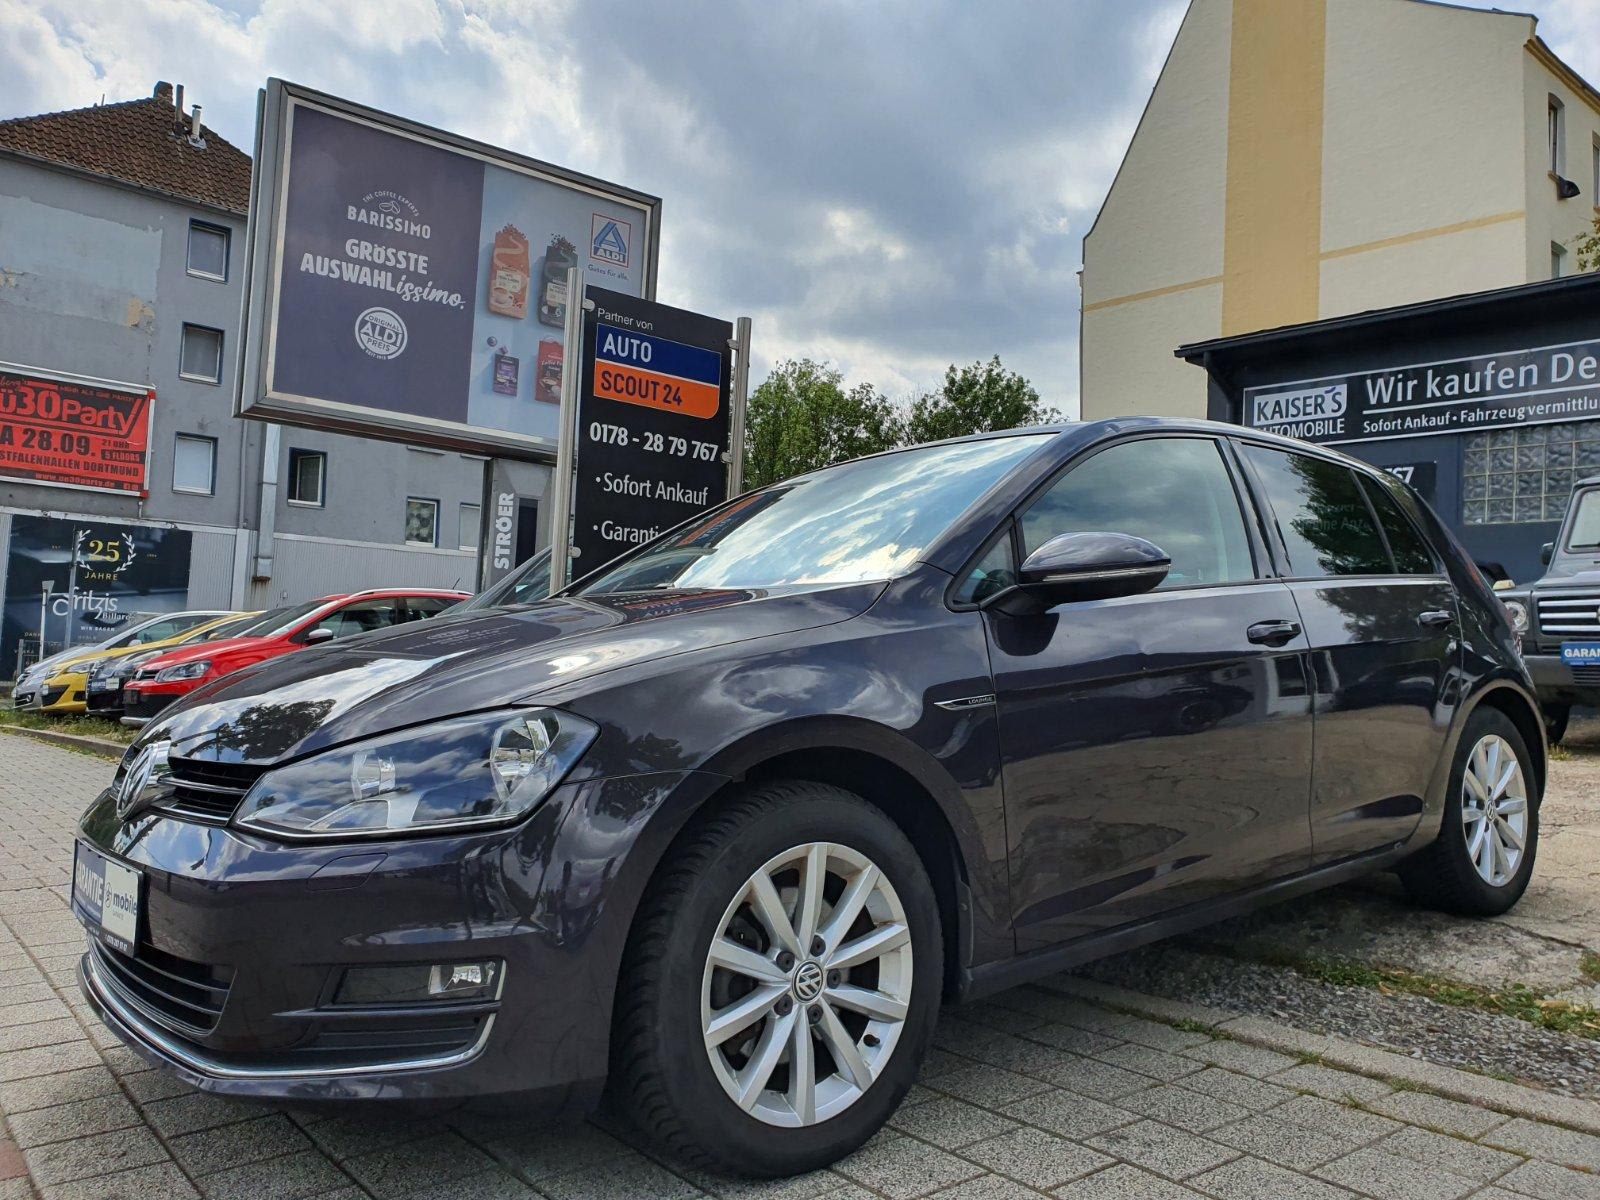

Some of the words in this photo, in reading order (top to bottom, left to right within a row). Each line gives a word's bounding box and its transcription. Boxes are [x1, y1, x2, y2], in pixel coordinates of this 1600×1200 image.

[347, 205, 431, 239] BARISSIMO
[345, 238, 429, 275] GRÖSSTE
[596, 248, 626, 263] ALDI
[368, 315, 400, 332] ORIGINAL
[597, 307, 634, 326] Partner
[636, 320, 653, 331] von
[360, 321, 403, 347] ALDI
[367, 338, 391, 352] PREIS
[603, 333, 652, 363] AUTO
[1365, 374, 1418, 405] Wir
[1426, 360, 1538, 399] kaufen
[1257, 418, 1345, 438] TOMOBILE
[1363, 419, 1402, 434] Sofort
[1404, 412, 1451, 430] Ankauf
[22, 427, 96, 457] 28.09.
[589, 422, 629, 446] 0178
[643, 431, 664, 453] 28
[668, 436, 688, 457] 79
[691, 440, 719, 461] 767
[84, 461, 139, 477] DORTMUND
[603, 472, 652, 498] Sofort
[655, 481, 709, 506] Ankauf
[494, 492, 515, 570] STRÖER
[88, 540, 121, 562] 25
[84, 571, 118, 581] JAHRE
